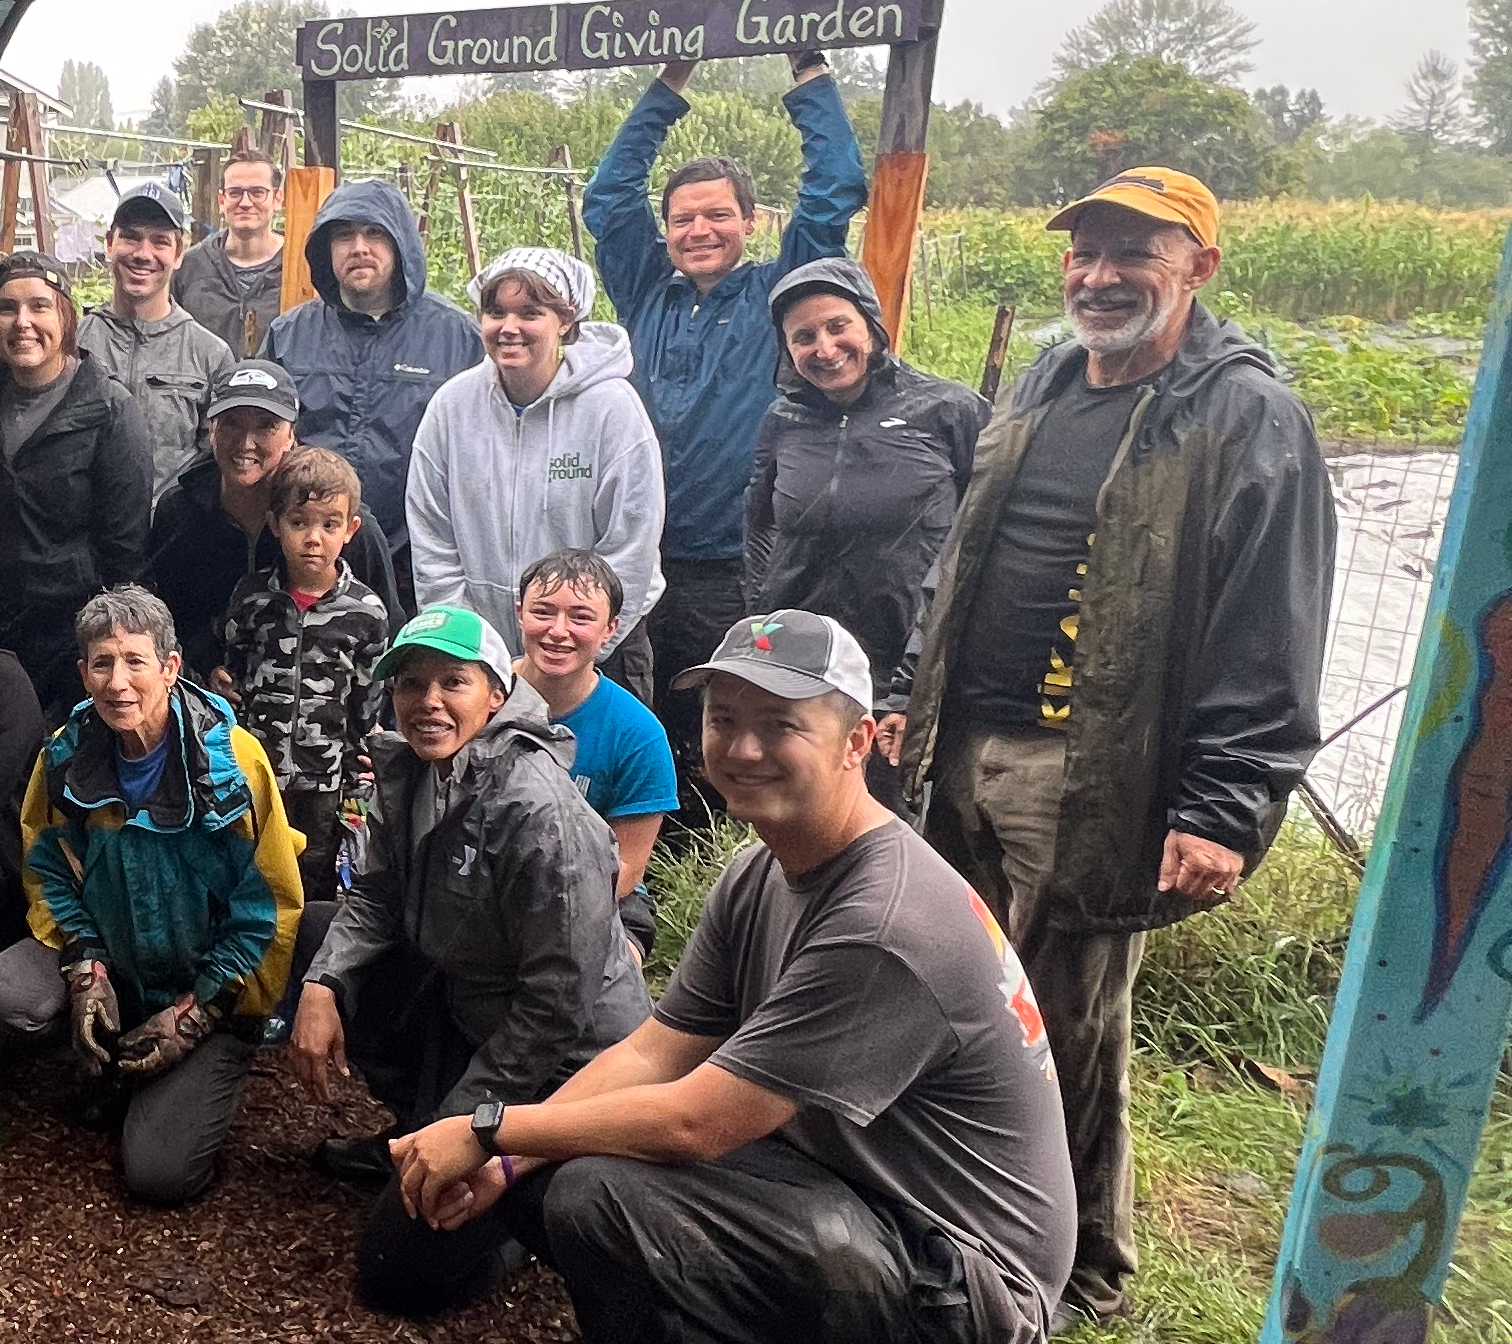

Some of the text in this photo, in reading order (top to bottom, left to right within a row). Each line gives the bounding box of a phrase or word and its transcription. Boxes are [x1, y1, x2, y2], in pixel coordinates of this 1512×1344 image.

[310, 17, 410, 77] Solid
[427, 6, 558, 66] Ground
[580, 4, 705, 61] Giving
